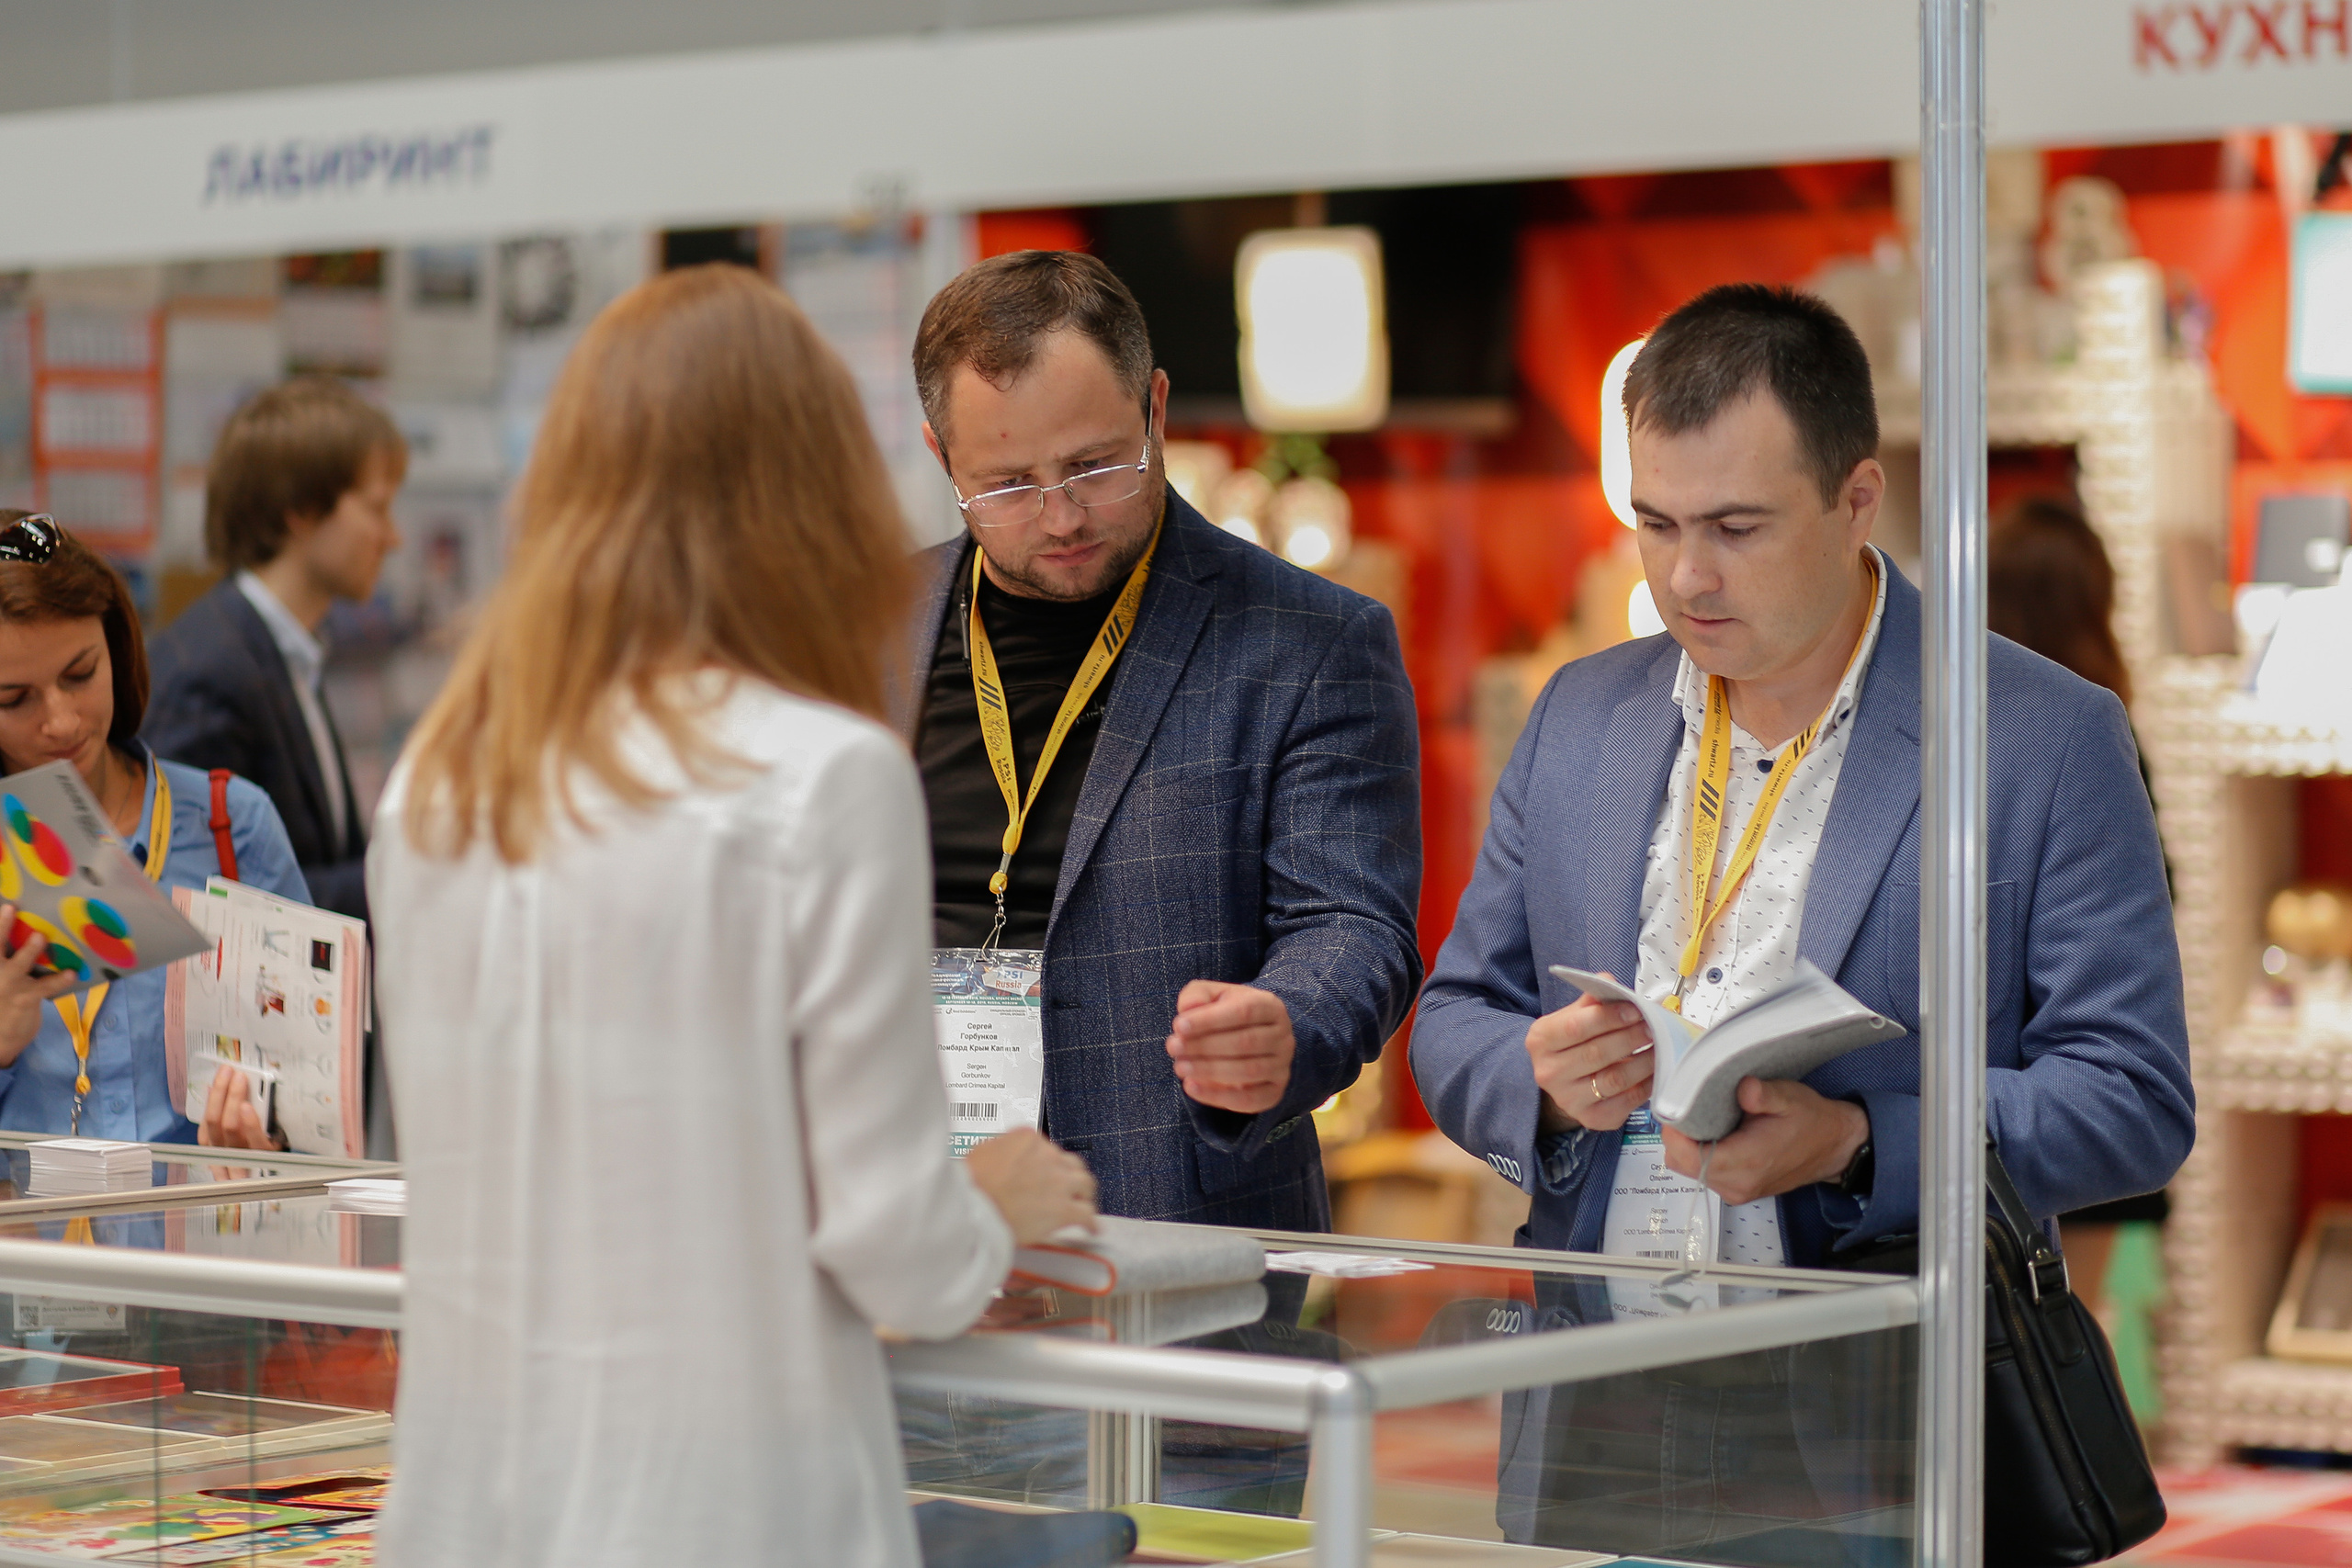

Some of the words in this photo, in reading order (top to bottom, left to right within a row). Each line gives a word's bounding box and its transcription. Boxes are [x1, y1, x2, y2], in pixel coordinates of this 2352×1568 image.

[201, 127, 496, 208] ЛАБИРИНТ
[1083, 654, 1105, 689] shwartz.ru
[1708, 739, 1720, 778] shwartz.ru
[995, 980, 1022, 988] Russia
